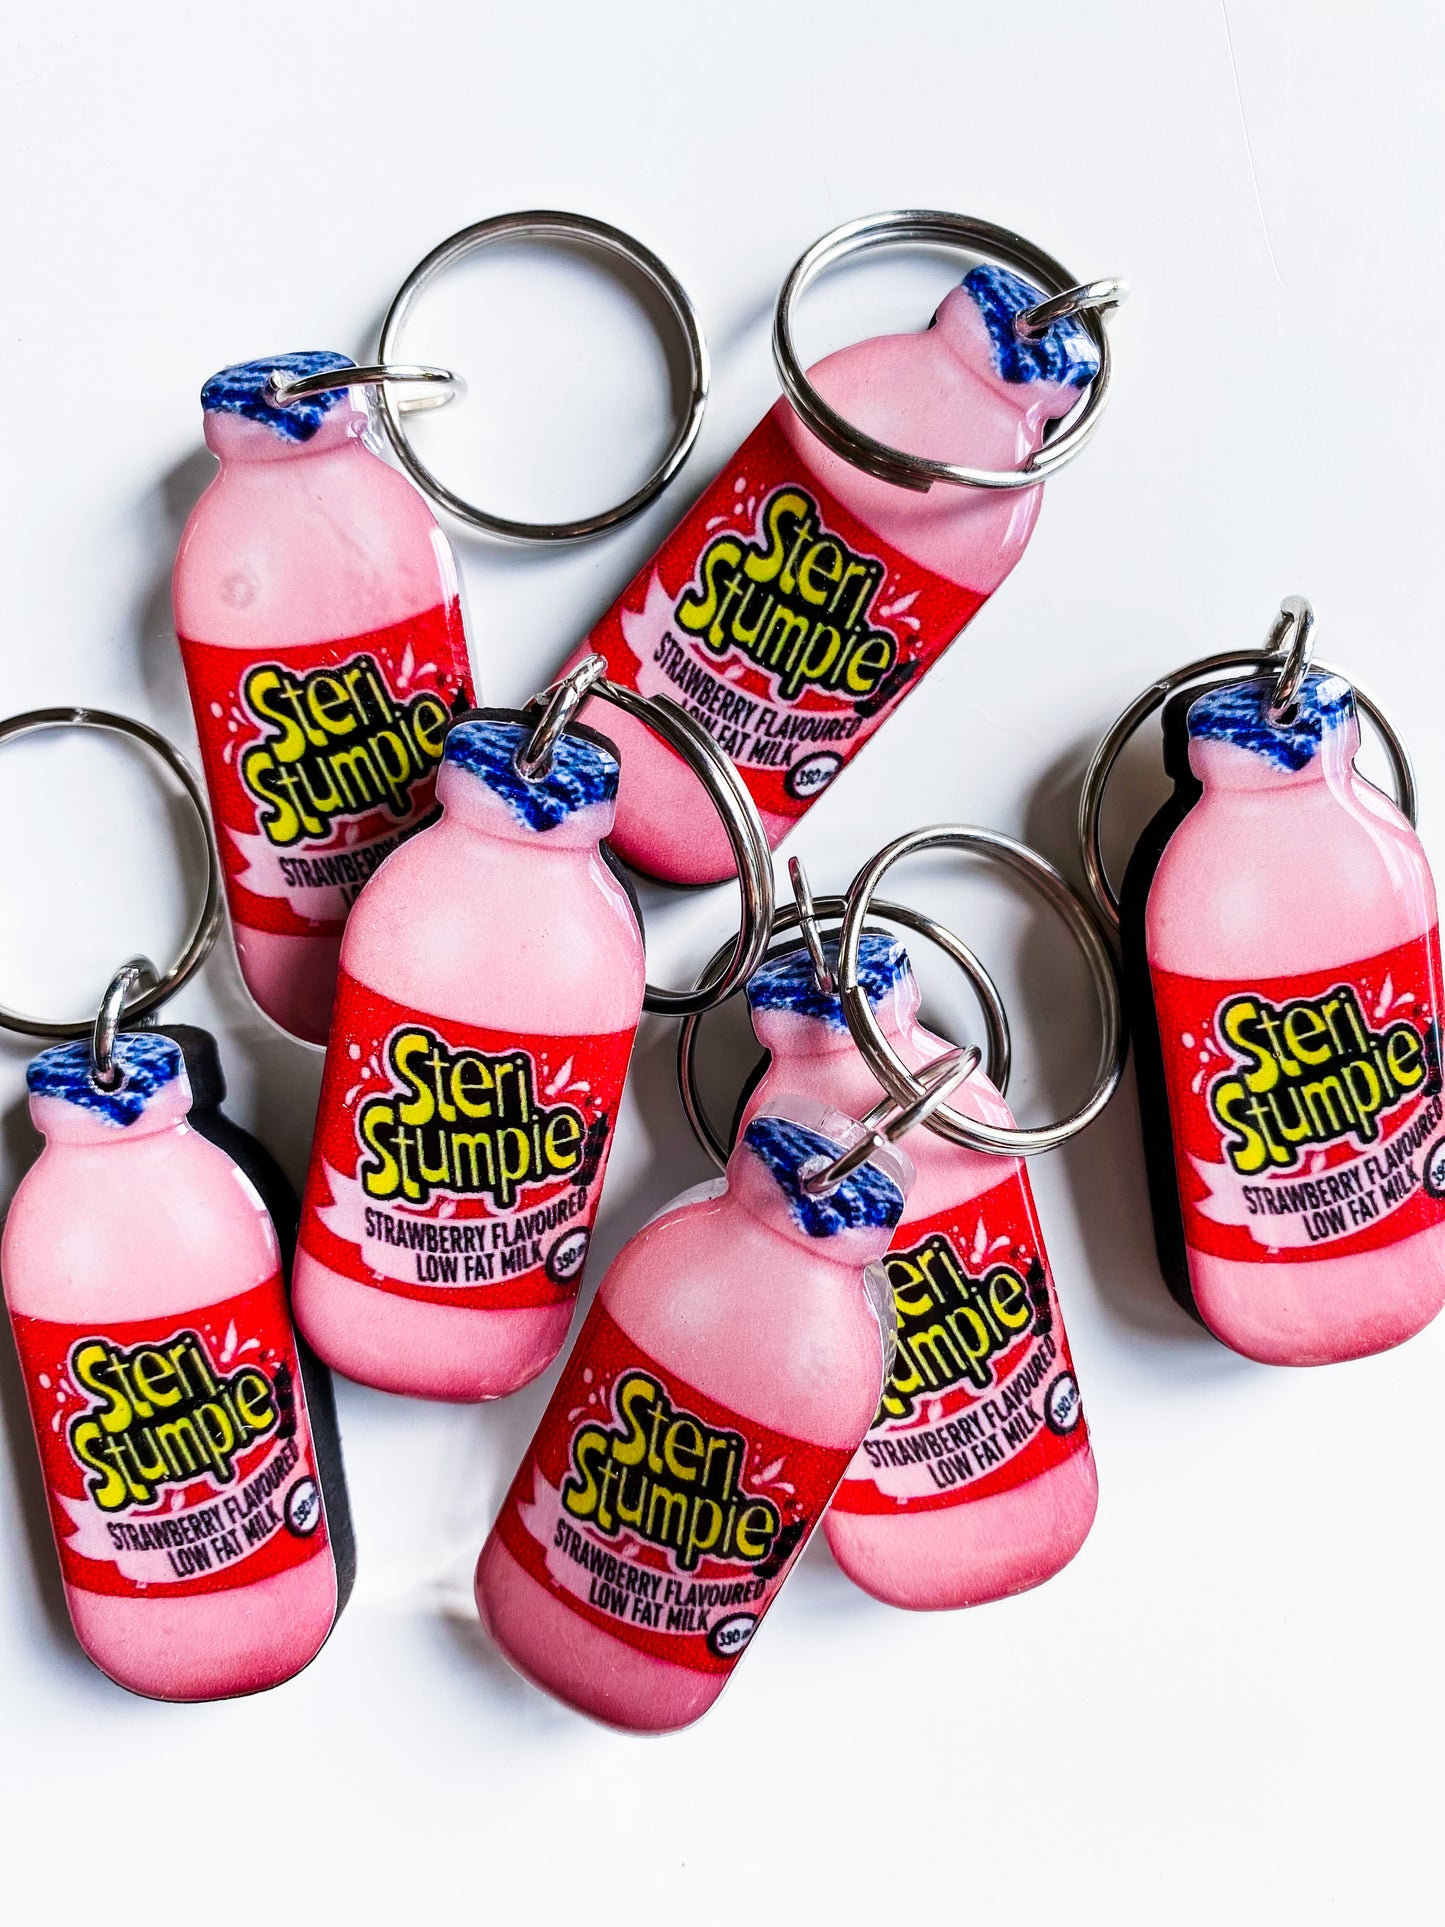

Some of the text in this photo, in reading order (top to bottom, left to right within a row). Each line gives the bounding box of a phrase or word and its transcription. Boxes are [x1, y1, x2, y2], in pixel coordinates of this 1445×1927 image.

[743, 493, 877, 630] Steri
[678, 542, 891, 694] Stumpie
[249, 660, 393, 763] Steri
[654, 631, 863, 742] STRAWBERRY FLAVOURED
[246, 700, 446, 842] Stumpie
[716, 725, 751, 758] FAT
[747, 735, 799, 767] MILK
[394, 1034, 528, 1125] Steri
[1225, 991, 1367, 1093] Steri
[1216, 1030, 1422, 1171] Stumpie
[363, 1105, 580, 1202] Stumpie
[1242, 1096, 1443, 1215] STRAWBERRY FLAVOURED
[1303, 1208, 1348, 1241] LOW
[1349, 1194, 1380, 1226] FAT
[1385, 1160, 1420, 1209] MILK
[365, 1187, 588, 1253] STRAWBERRY FLAVOURED
[416, 1252, 458, 1282] LOW
[464, 1257, 495, 1281] FAT
[501, 1239, 544, 1276] MILK
[885, 1240, 968, 1327] eri
[77, 1337, 217, 1432] Steri
[874, 1273, 1029, 1420] umpie
[74, 1375, 274, 1508] Stumpie
[612, 1379, 738, 1500] Steri
[863, 1335, 1056, 1468] STRAWBERRY FLAVOURED
[926, 1402, 1043, 1489] LOW FAT MILK
[106, 1440, 299, 1550] STRAWBERRY FLAVOURED
[167, 1502, 282, 1577] LOW FAT MILK
[566, 1432, 774, 1566] Stumpie
[554, 1518, 766, 1608] STRAWBERRY FLAVOURED
[589, 1576, 711, 1632] LOW FAT MILK
